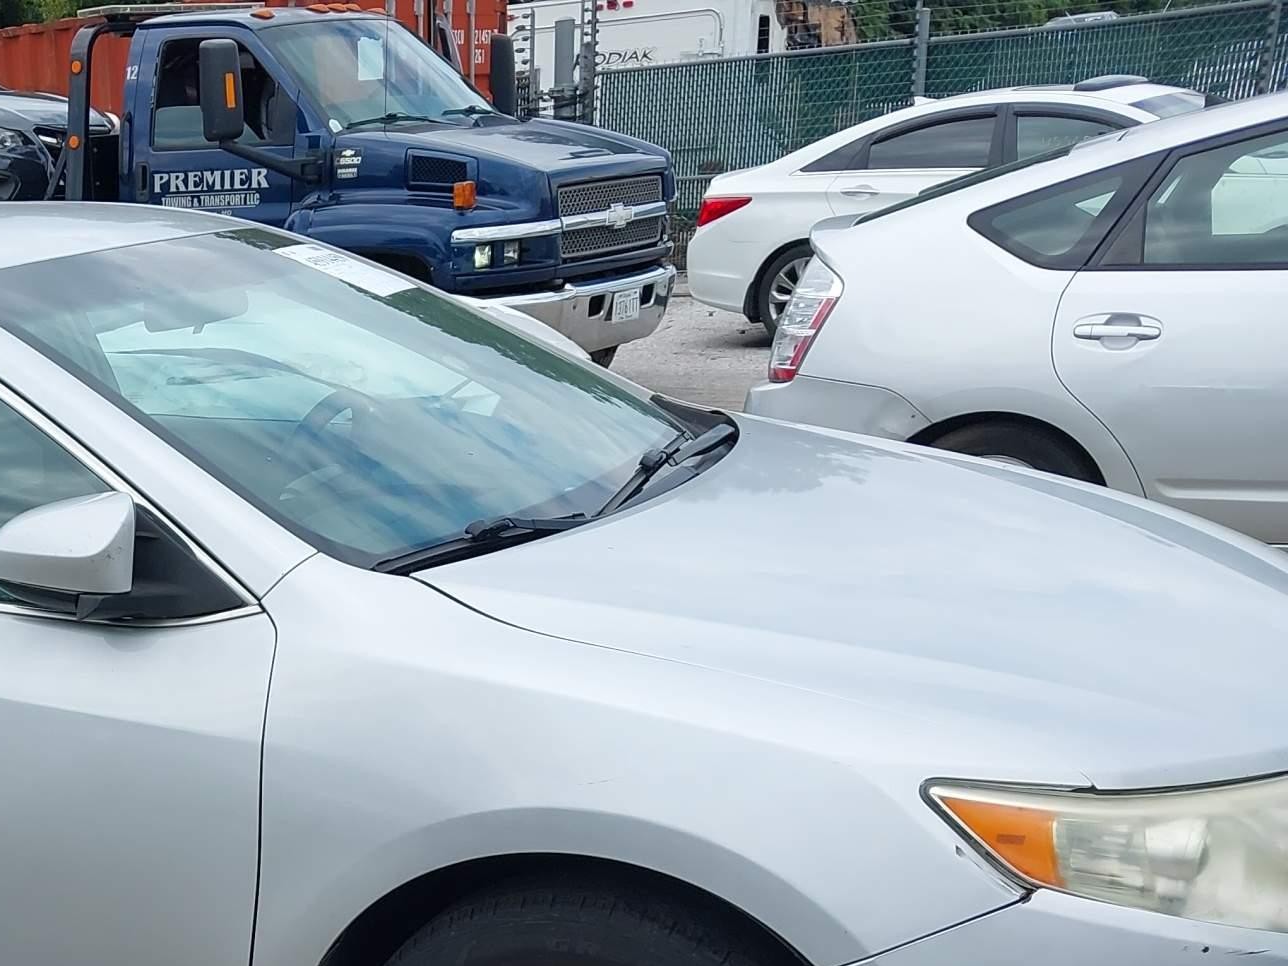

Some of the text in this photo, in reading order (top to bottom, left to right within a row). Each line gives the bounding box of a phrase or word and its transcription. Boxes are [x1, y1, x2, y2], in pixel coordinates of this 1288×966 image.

[126, 65, 138, 80] 12
[153, 168, 269, 193] PREMIER
[161, 193, 260, 208] TOWING & TRANSPORT LLC
